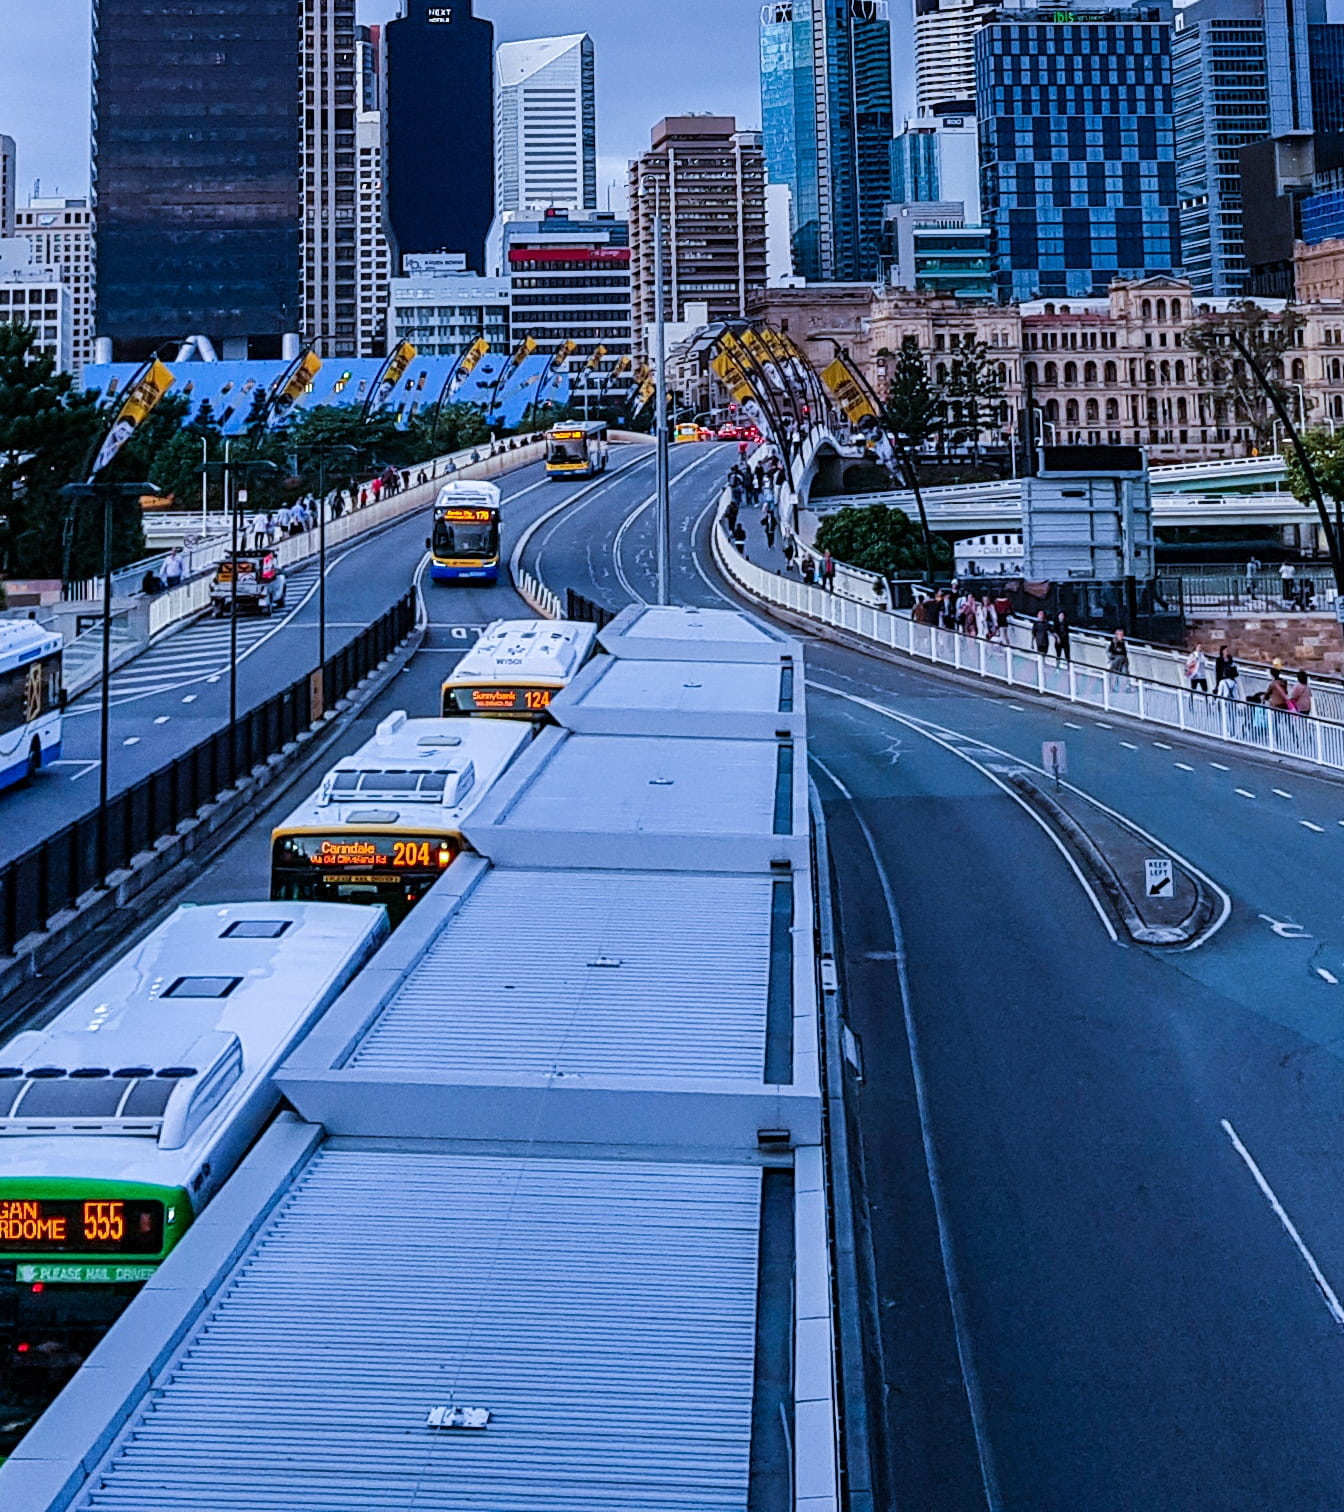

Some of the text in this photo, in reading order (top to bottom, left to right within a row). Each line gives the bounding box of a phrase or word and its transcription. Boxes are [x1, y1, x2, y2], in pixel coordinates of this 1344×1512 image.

[1053, 11, 1074, 23] ibis
[472, 690, 516, 701] Sunnybank
[524, 691, 551, 708] 124
[321, 841, 430, 866] Carindale 204
[84, 1202, 124, 1240] 555
[39, 1268, 82, 1281] PLEASE
